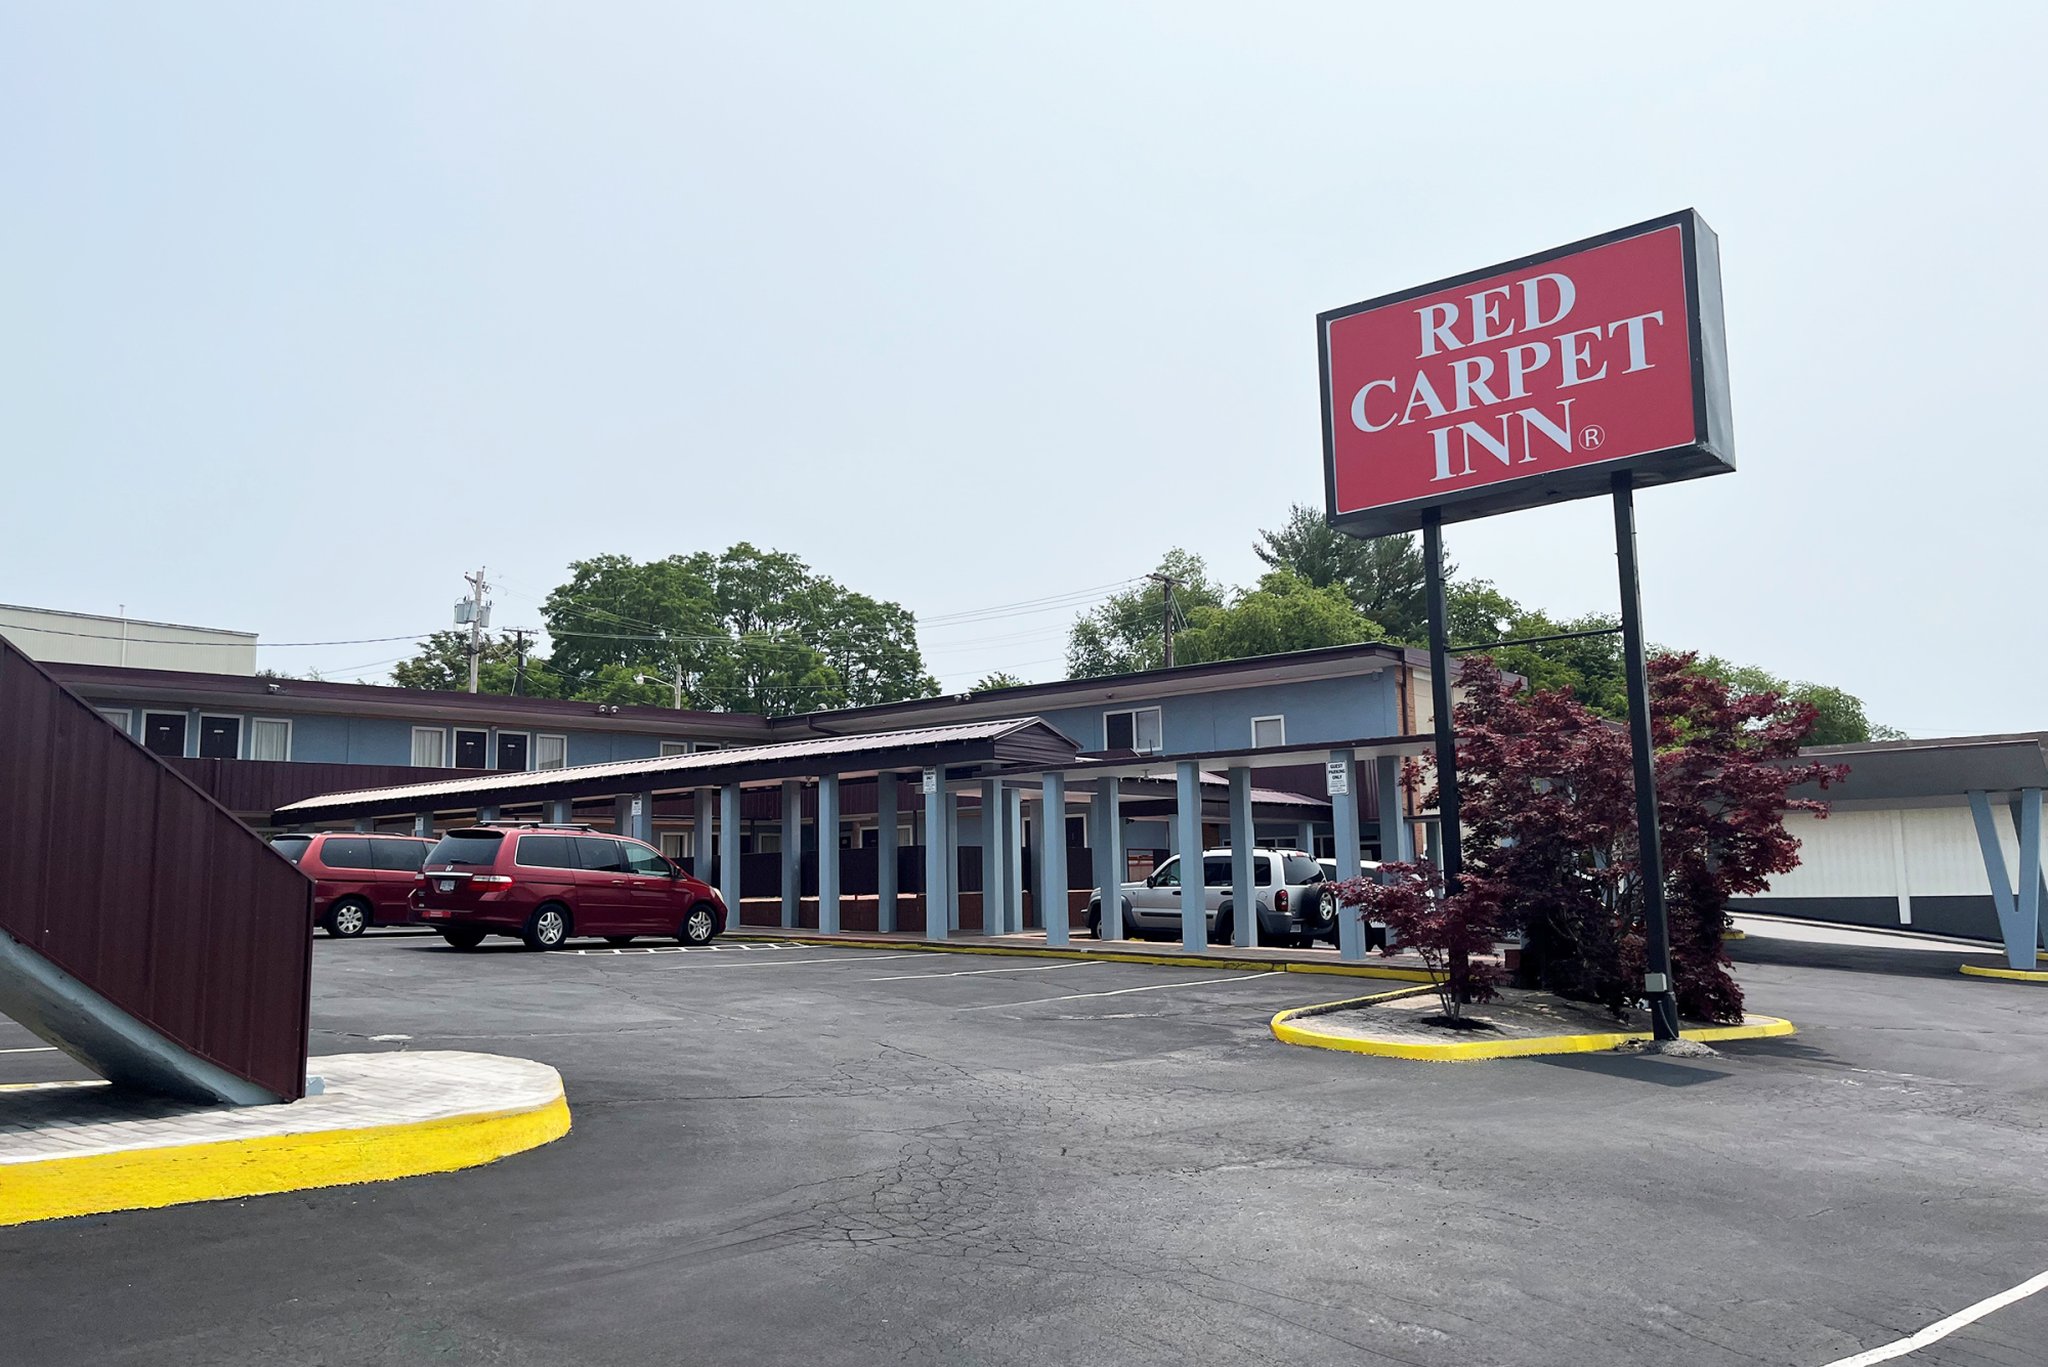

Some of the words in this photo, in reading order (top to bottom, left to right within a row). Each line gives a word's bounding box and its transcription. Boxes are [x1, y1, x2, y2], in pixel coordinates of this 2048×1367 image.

[1413, 273, 1576, 360] RED
[1351, 310, 1664, 433] CARPET
[1427, 398, 1577, 483] INN
